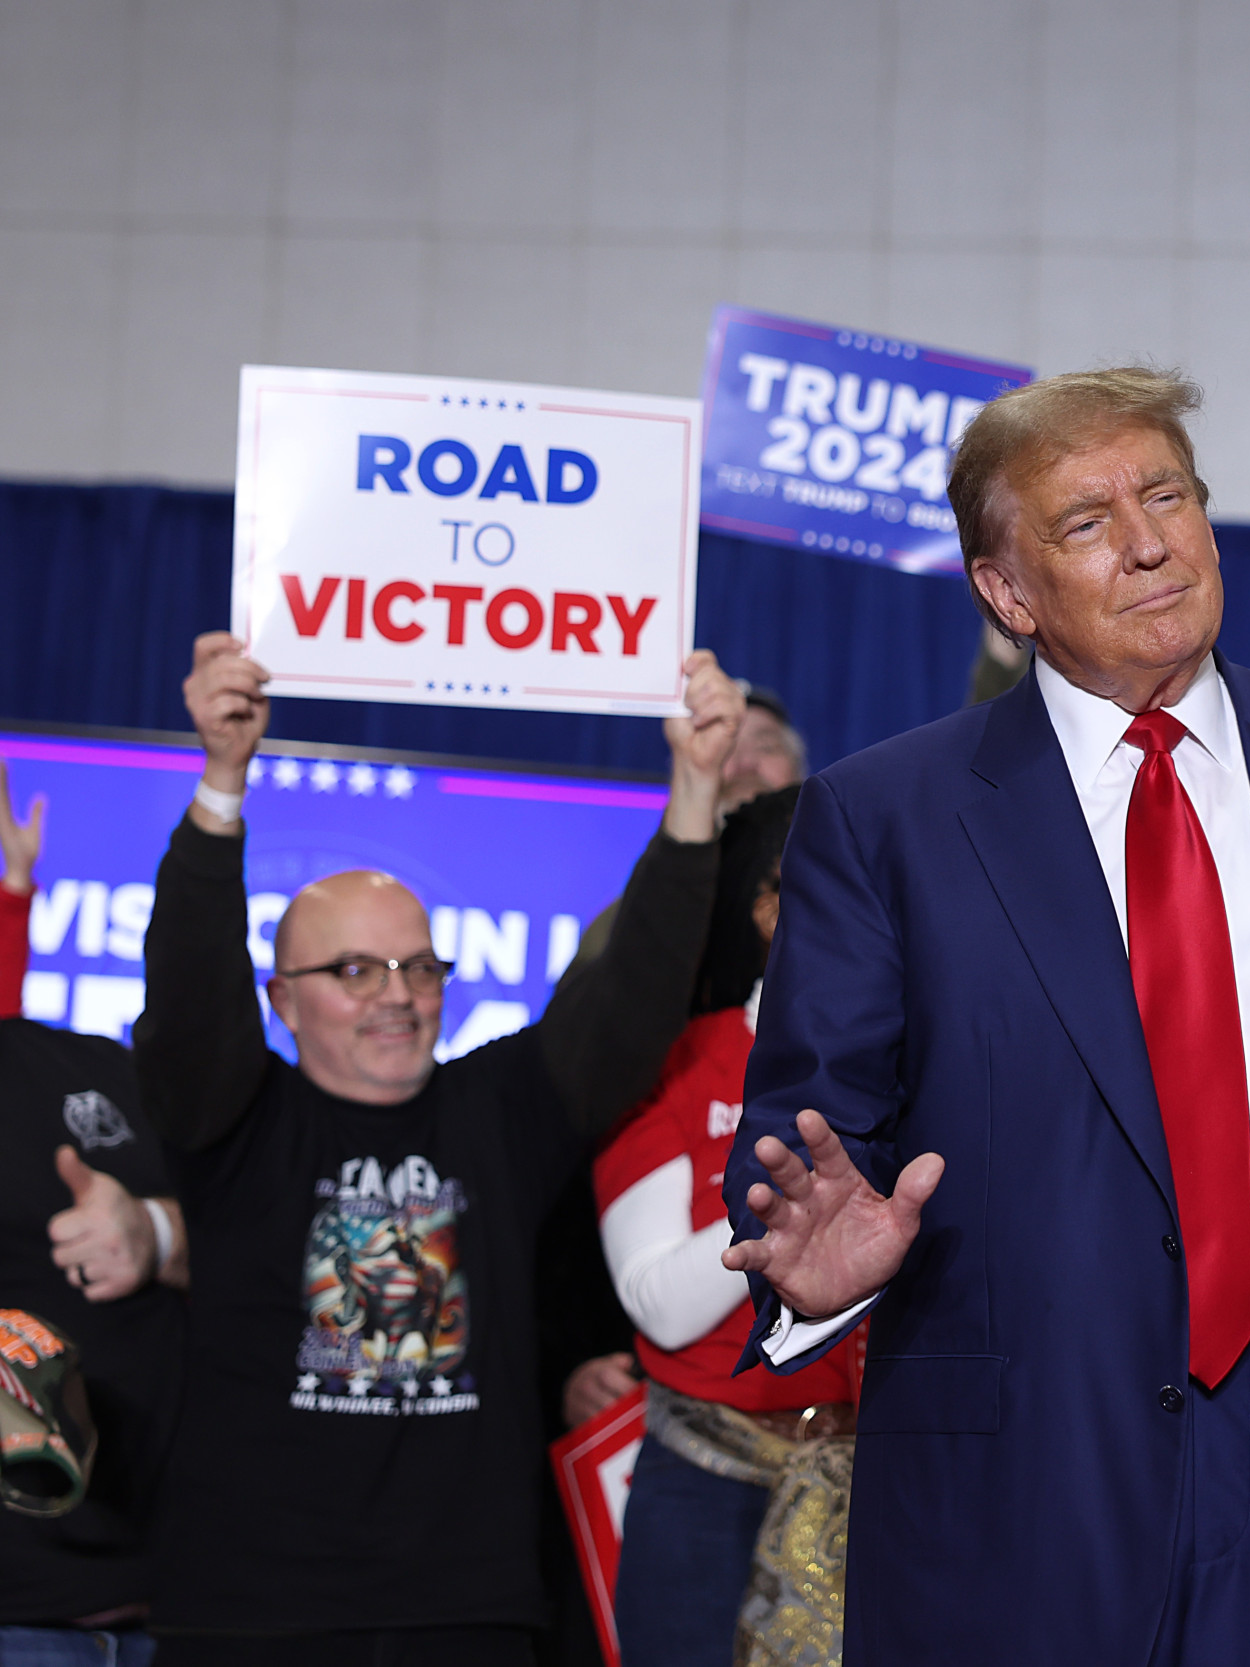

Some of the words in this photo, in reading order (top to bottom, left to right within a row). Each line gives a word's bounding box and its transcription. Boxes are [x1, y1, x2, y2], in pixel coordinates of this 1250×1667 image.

[356, 434, 599, 506] ROAD
[759, 414, 948, 501] 2024
[441, 519, 515, 566] TO
[279, 574, 660, 657] VICTORY
